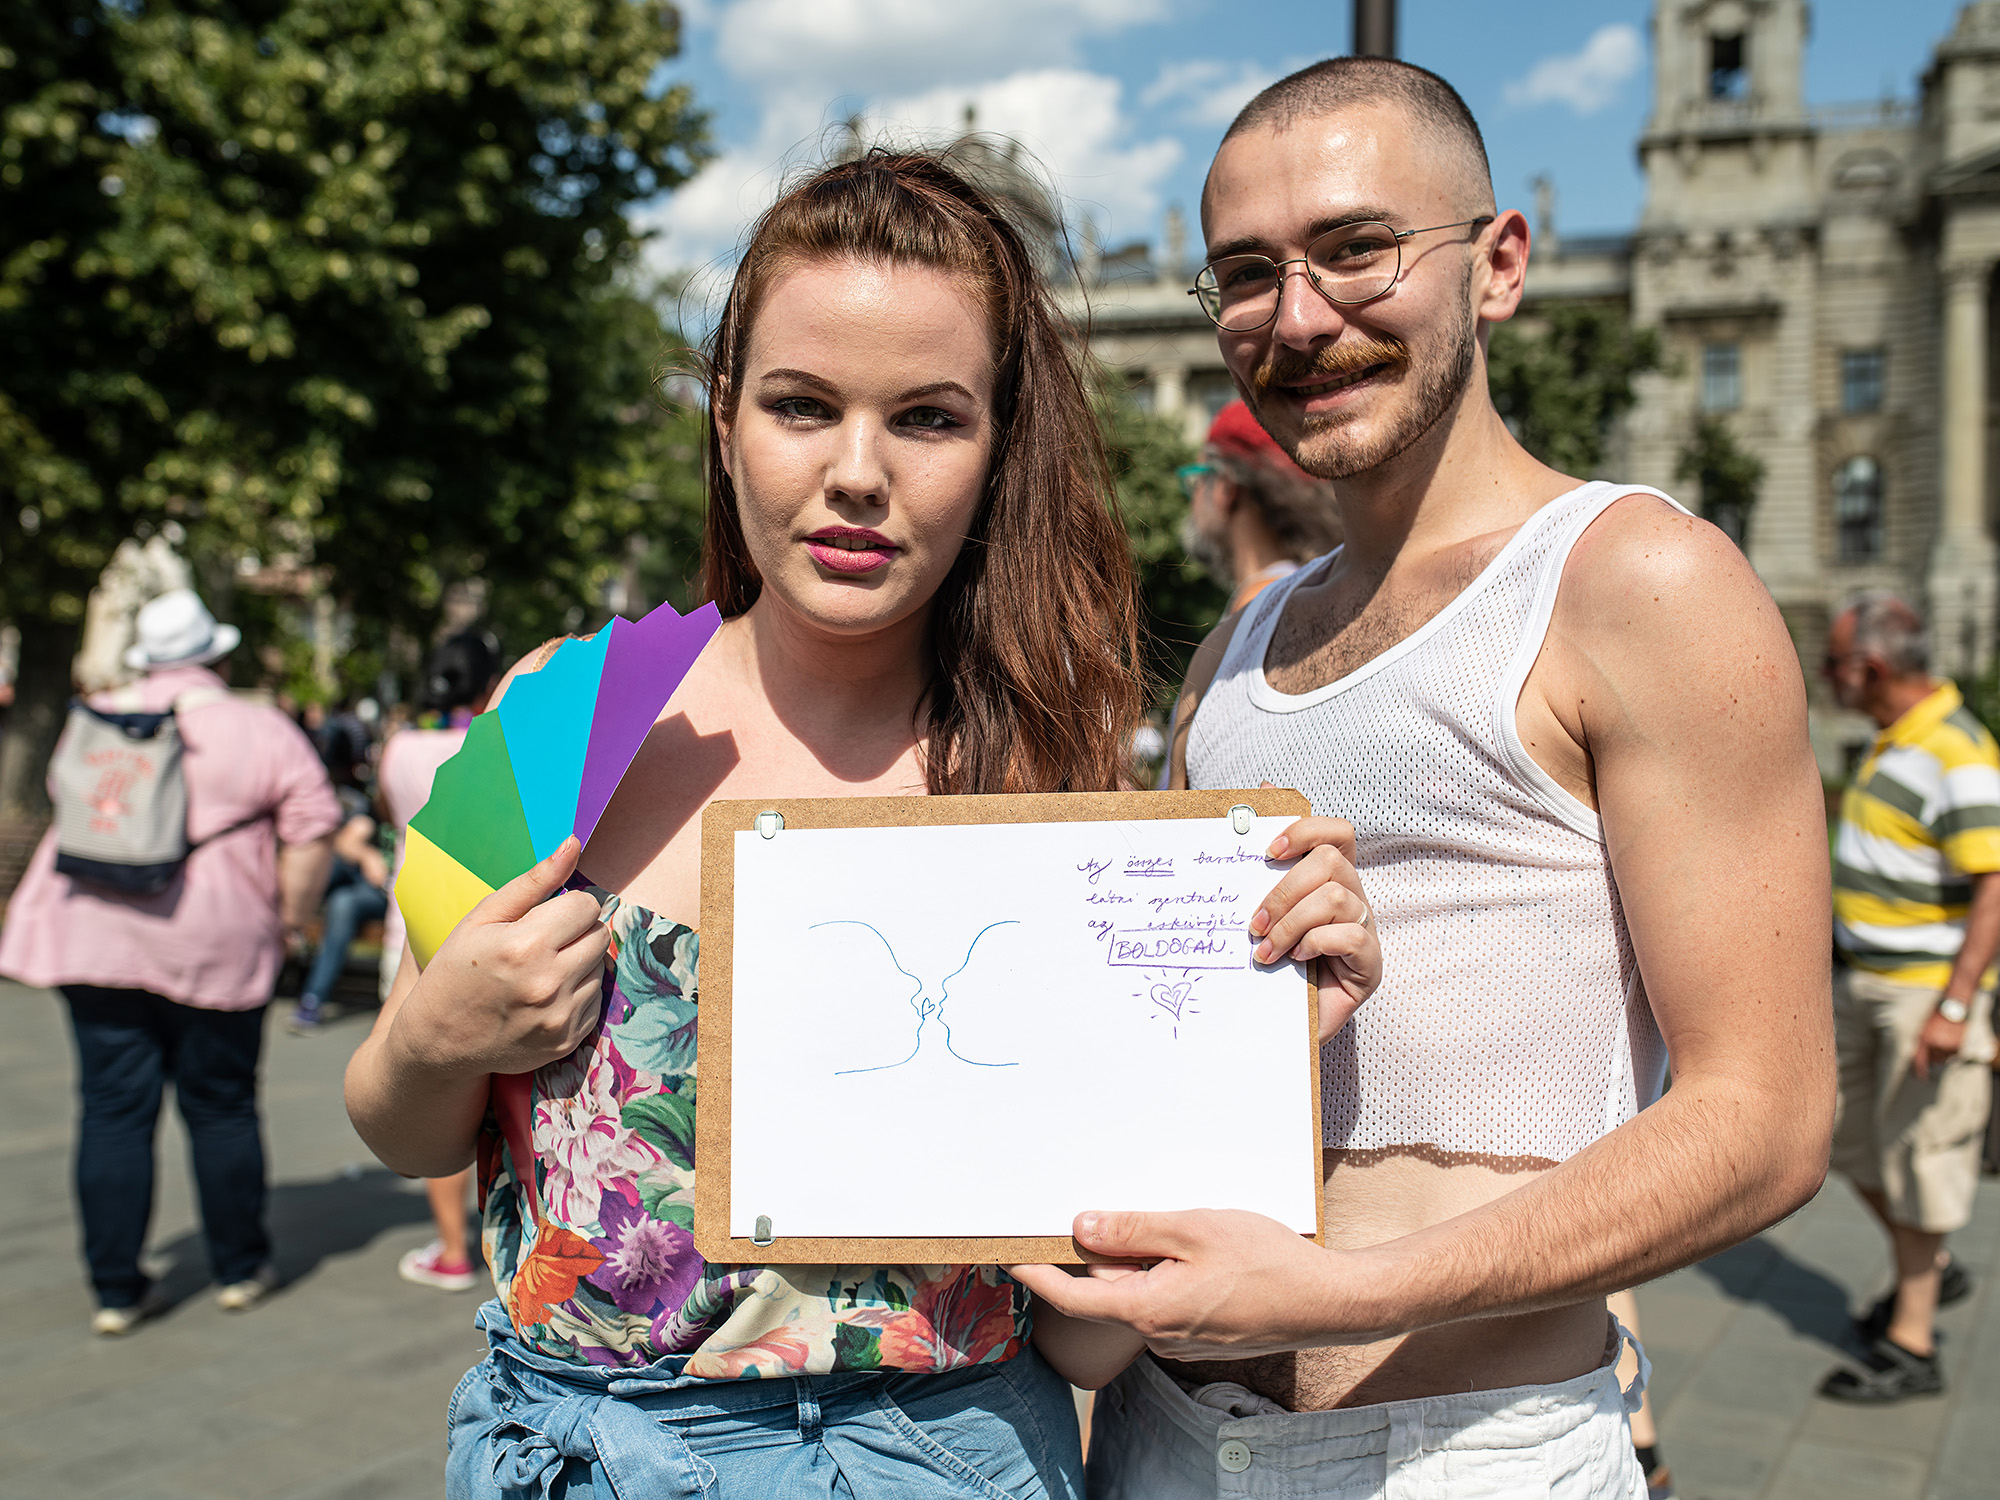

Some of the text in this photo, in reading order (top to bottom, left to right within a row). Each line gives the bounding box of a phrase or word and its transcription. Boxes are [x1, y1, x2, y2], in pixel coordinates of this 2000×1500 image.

[1127, 855, 1174, 877] összes
[1148, 887, 1239, 913] szeretném
[1087, 919, 1114, 941] az
[1115, 937, 1234, 960] BOLDOGAN.
